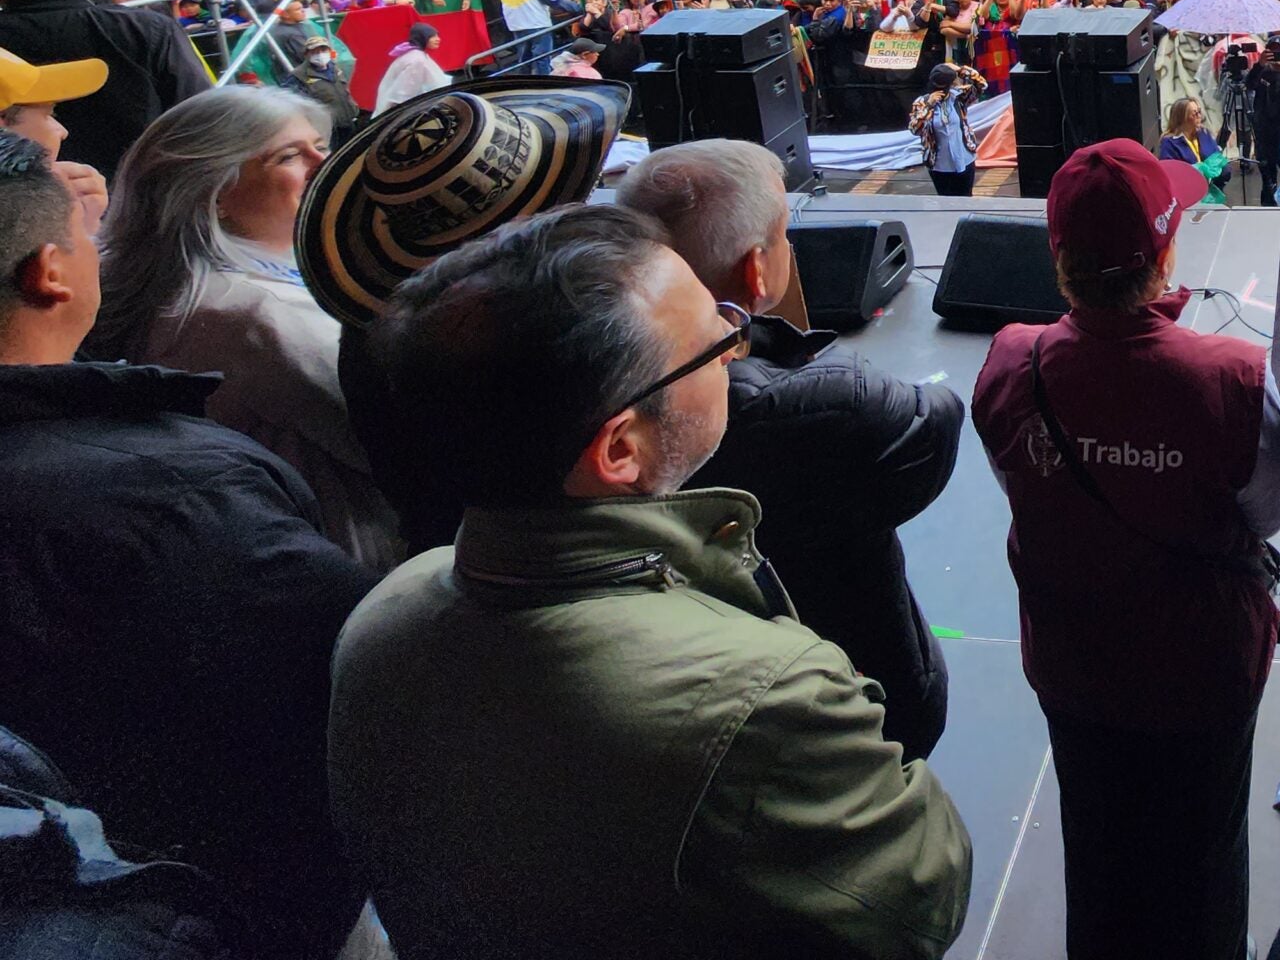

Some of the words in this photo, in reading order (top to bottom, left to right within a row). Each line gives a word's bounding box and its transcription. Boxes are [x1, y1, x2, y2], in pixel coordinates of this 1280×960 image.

[878, 49, 899, 57] SON
[903, 50, 919, 58] LOS
[1077, 437, 1183, 472] Trabajo
